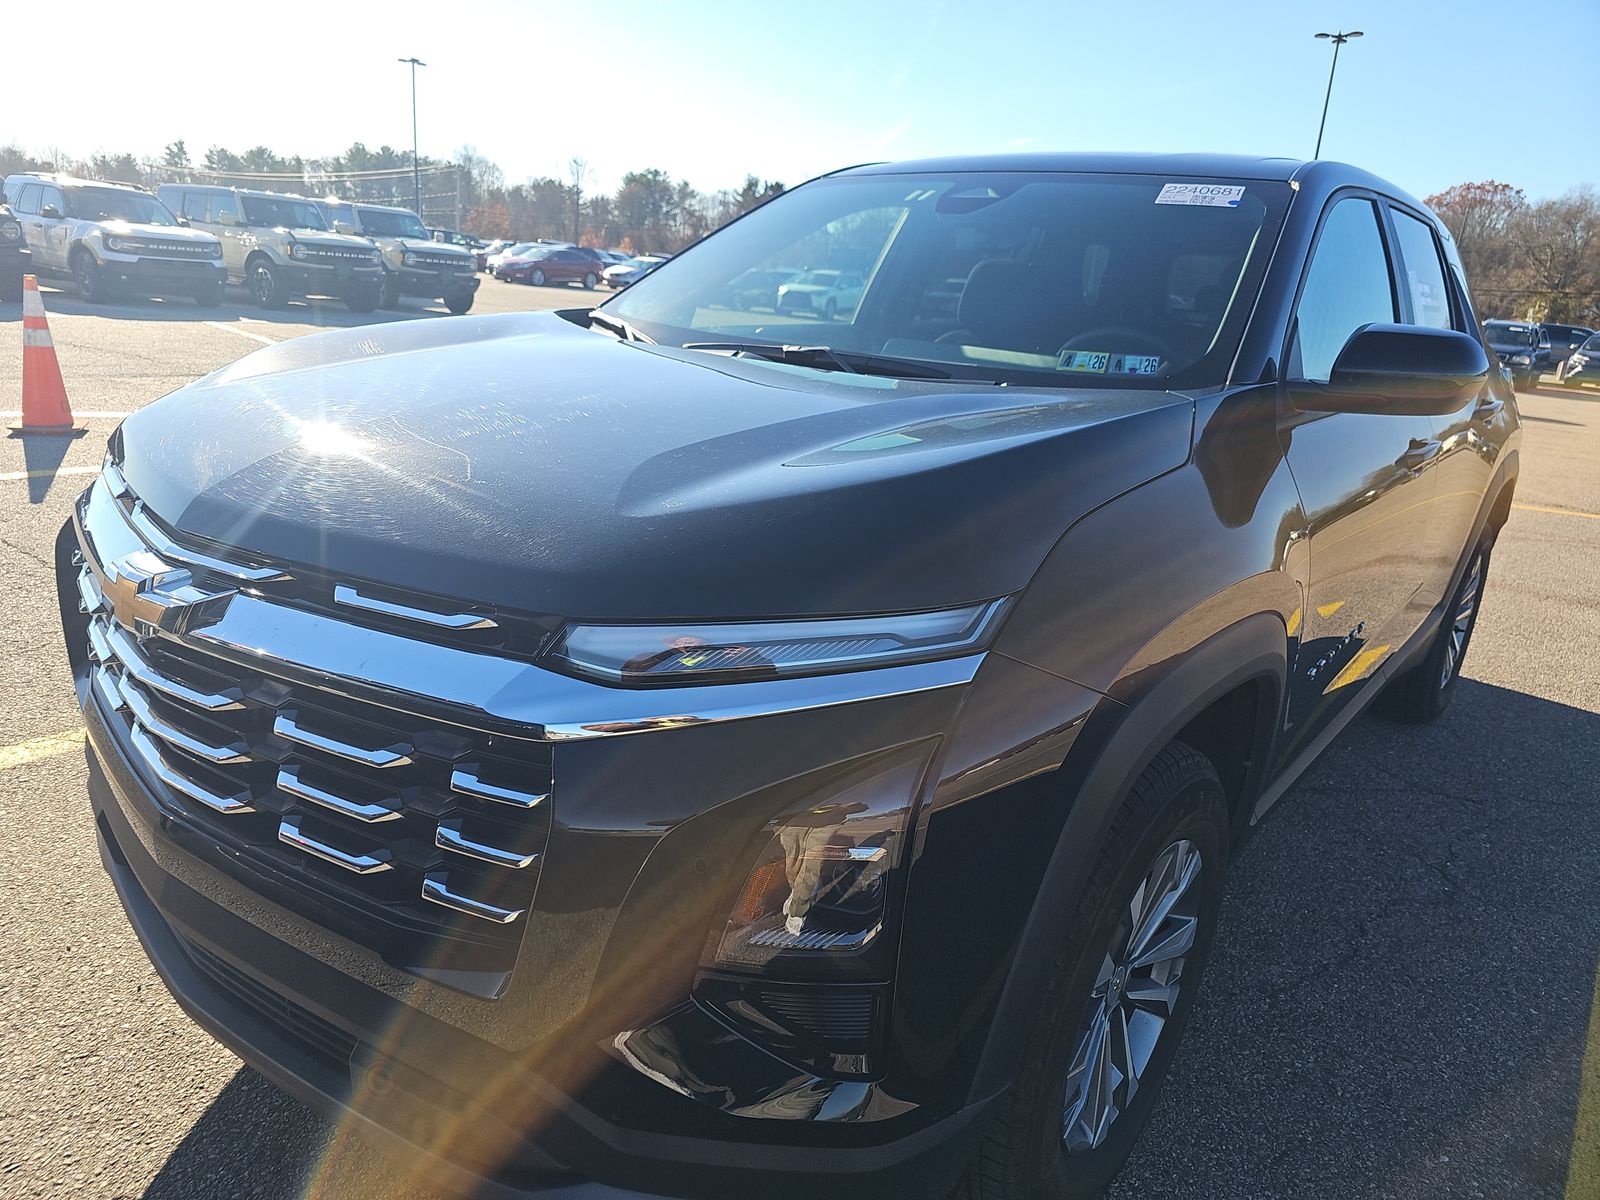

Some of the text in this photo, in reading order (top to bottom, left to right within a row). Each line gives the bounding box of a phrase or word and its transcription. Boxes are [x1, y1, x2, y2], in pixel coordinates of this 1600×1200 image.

[1164, 185, 1243, 196] 2240681
[1091, 355, 1106, 369] 26
[1143, 358, 1157, 373] 26
